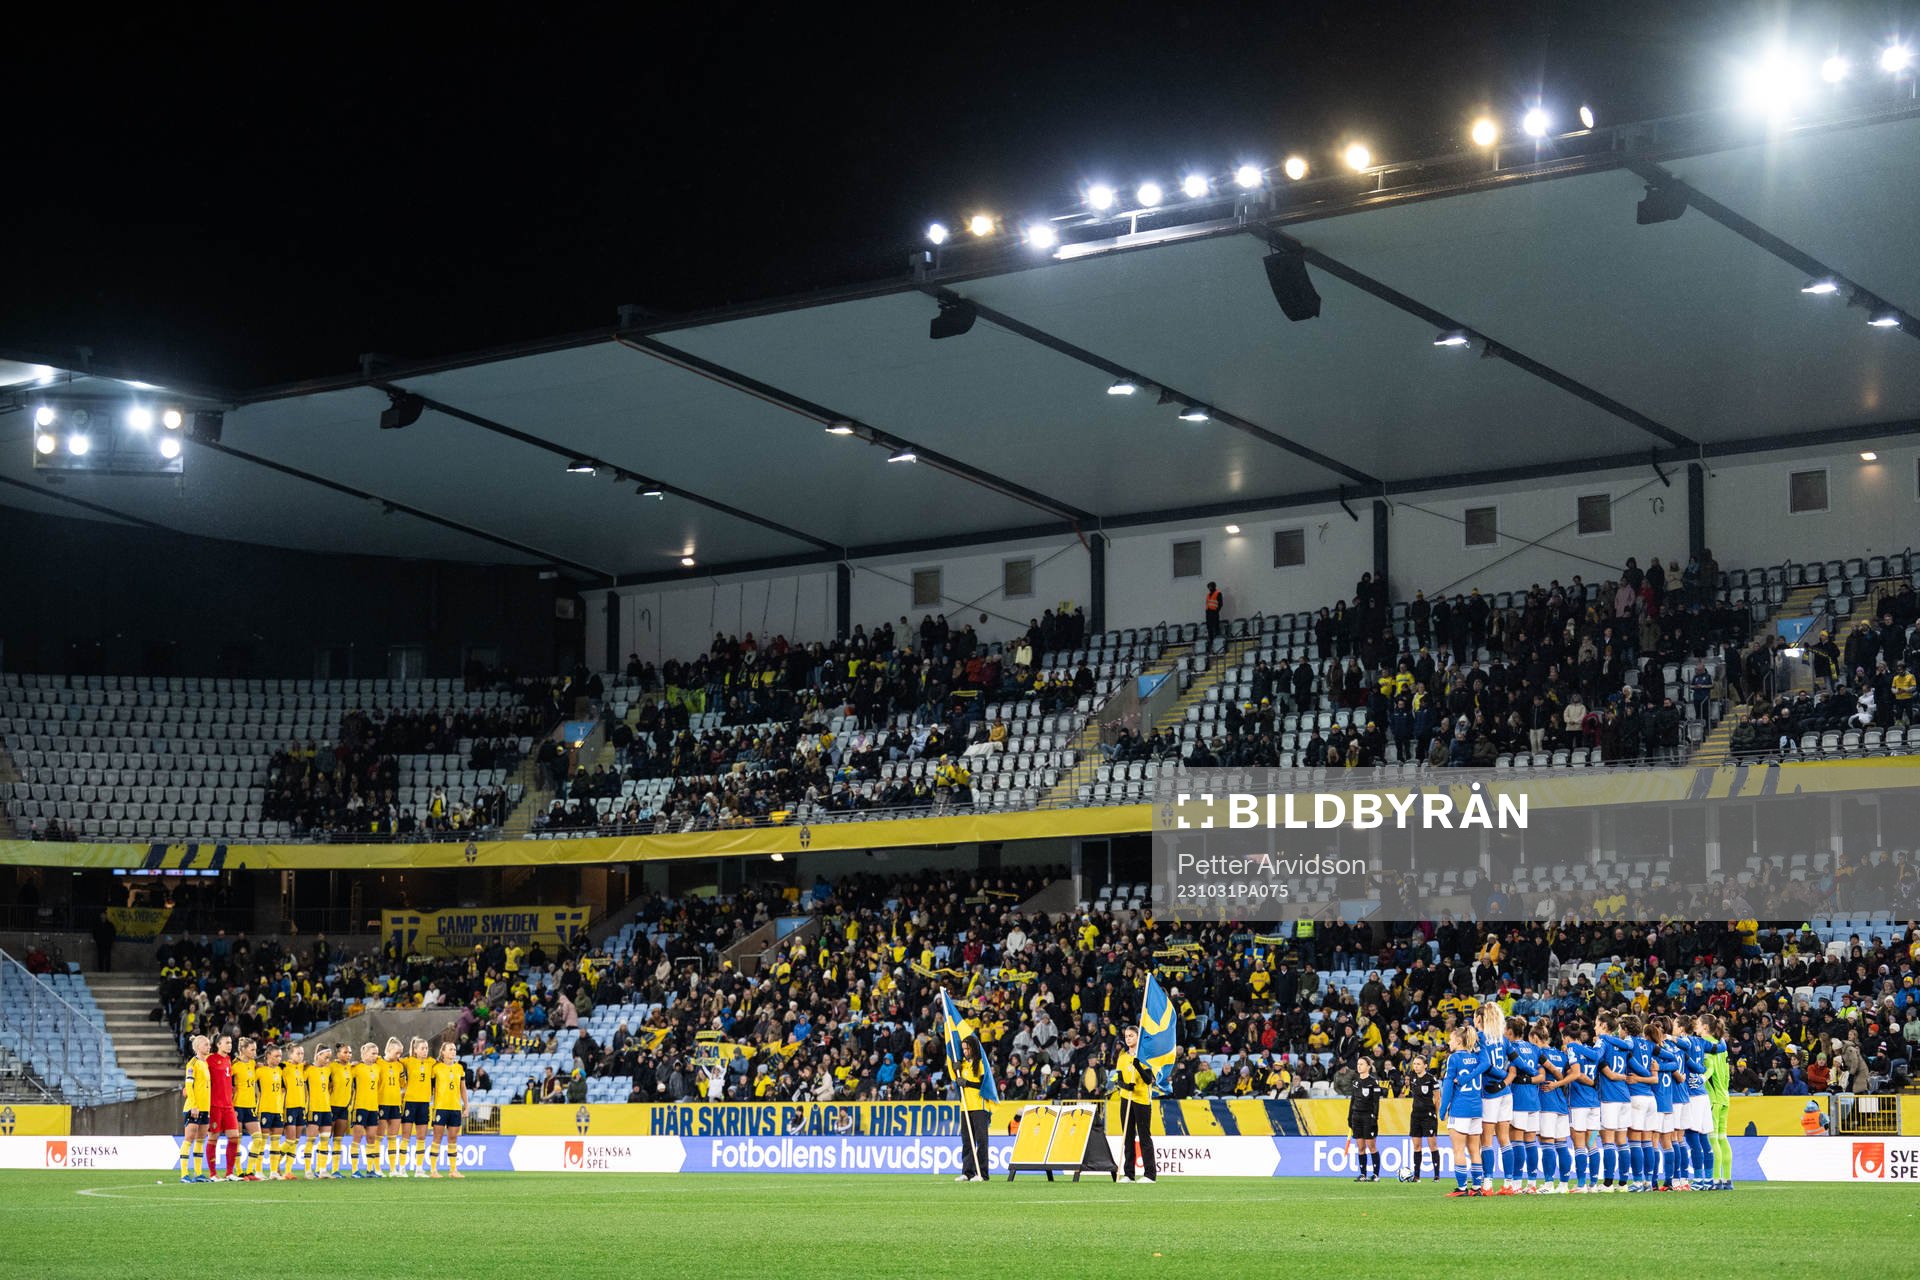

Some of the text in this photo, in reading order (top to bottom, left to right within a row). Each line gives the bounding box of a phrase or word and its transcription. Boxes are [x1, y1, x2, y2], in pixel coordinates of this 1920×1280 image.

[438, 913, 539, 934] CAMP SWEDEN
[1491, 1046, 1504, 1070] 15
[1612, 1055, 1625, 1073] 19
[345, 1078, 350, 1087] 7
[388, 1077, 396, 1086] 11
[419, 1073, 425, 1082] 3
[1458, 1068, 1482, 1092] 20
[271, 1082, 280, 1092] 19
[370, 1081, 376, 1090] 2
[449, 1081, 455, 1090] 6
[651, 1103, 960, 1136] HÄR SKRIVS BÅGL HISTORI
[71, 1146, 118, 1156] SVENSKA
[587, 1147, 632, 1157] SVENSKA
[1156, 1148, 1211, 1159] SVENSKA
[712, 1139, 1012, 1174] Fotbollens huvudsposo
[1891, 1150, 1919, 1163] SVE
[71, 1157, 95, 1167] SPEL
[587, 1159, 609, 1169] SPEL
[1156, 1162, 1184, 1172] SPEL
[1891, 1166, 1918, 1178] SPE
